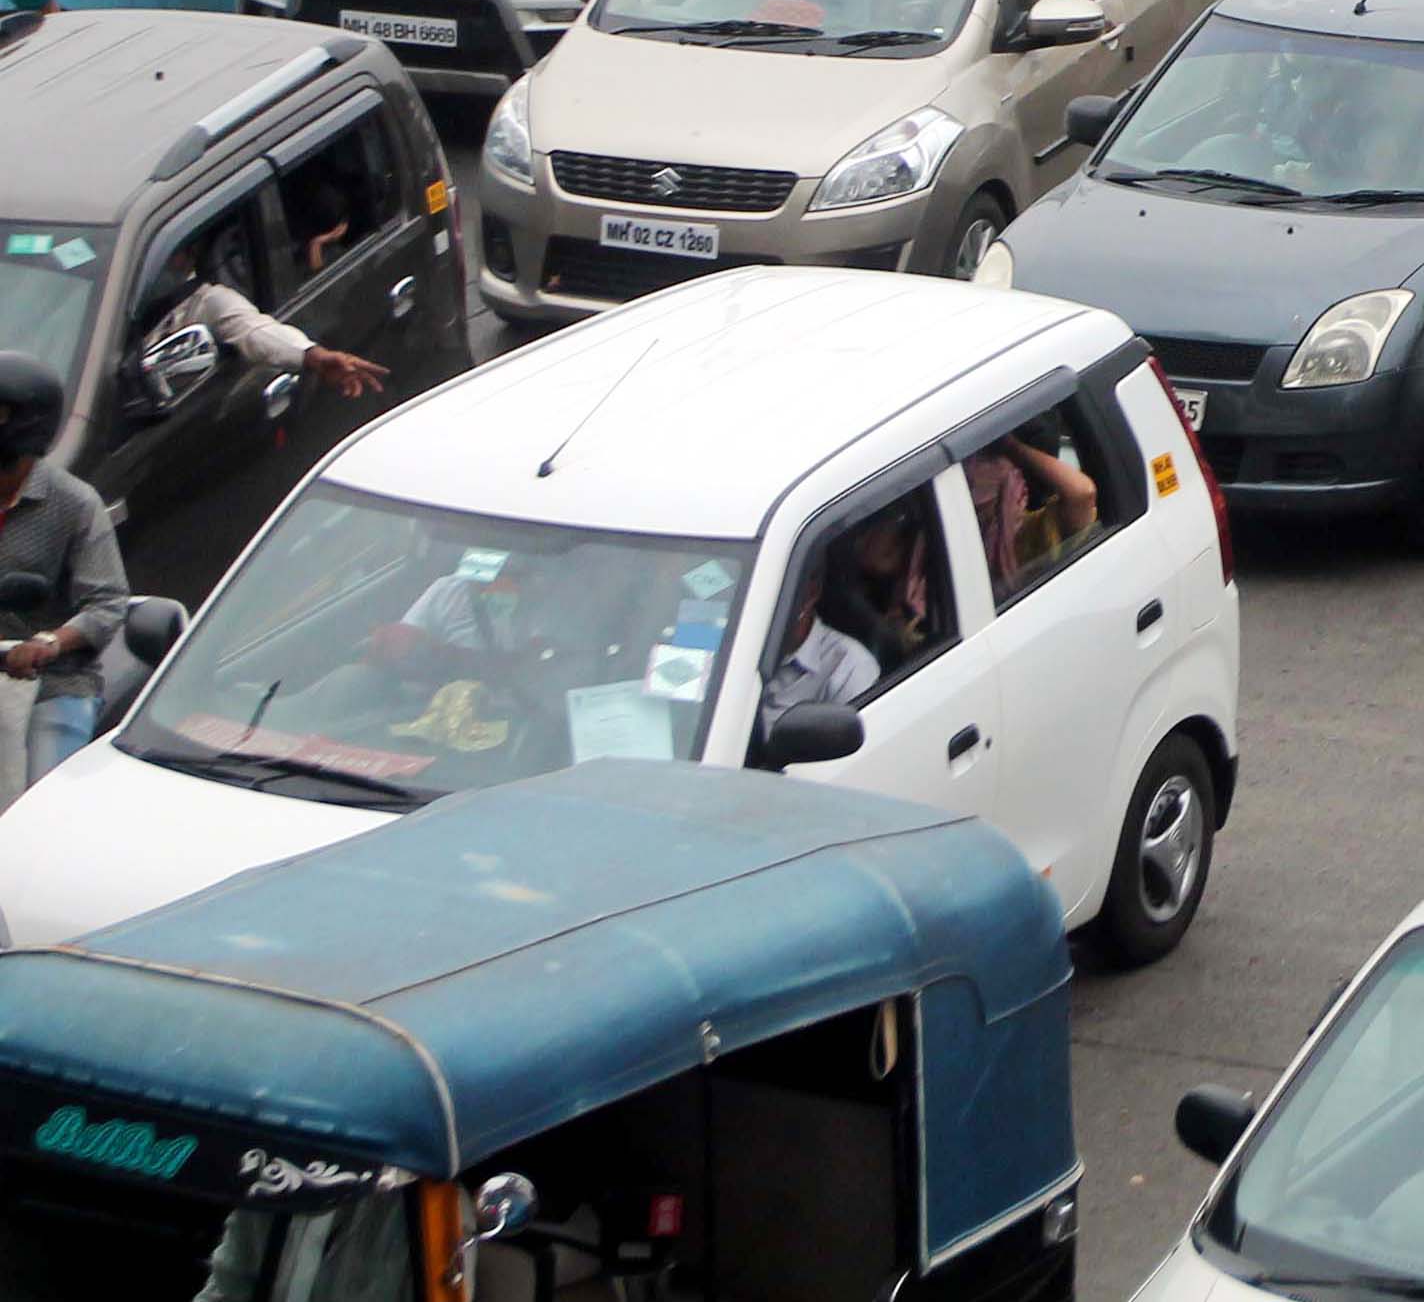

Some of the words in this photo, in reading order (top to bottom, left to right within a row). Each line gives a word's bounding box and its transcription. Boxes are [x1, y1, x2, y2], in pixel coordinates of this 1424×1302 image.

[373, 21, 392, 38] 48
[608, 222, 631, 241] MH
[634, 226, 651, 245] 02
[655, 230, 675, 248] CZ
[679, 233, 714, 254] 1260
